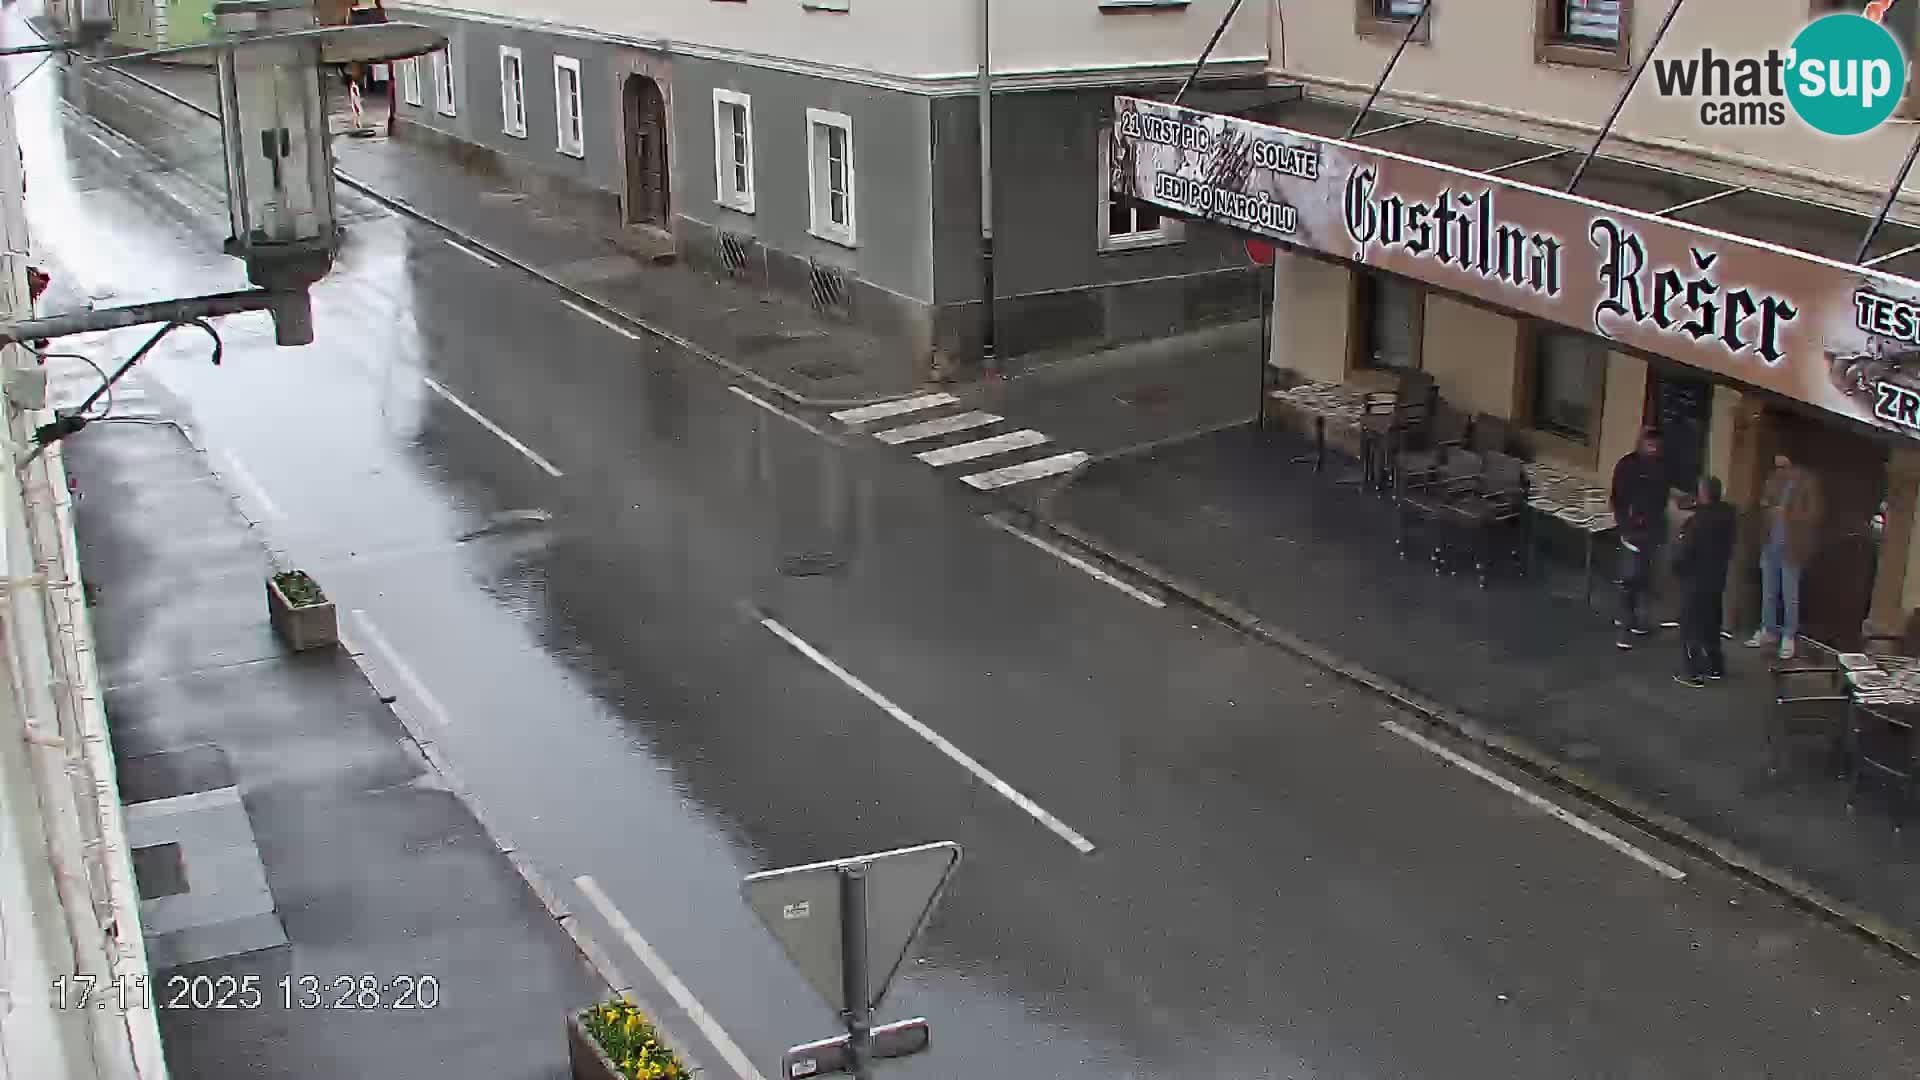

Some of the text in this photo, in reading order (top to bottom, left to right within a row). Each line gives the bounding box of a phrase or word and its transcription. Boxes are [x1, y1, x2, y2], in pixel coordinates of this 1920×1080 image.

[1121, 112, 1210, 152] 21 VRST PIC
[1254, 140, 1319, 179] SOLATE
[1156, 172, 1296, 233] JEDI PO NAROČILU
[1345, 162, 1798, 363] Gostilna Rešer
